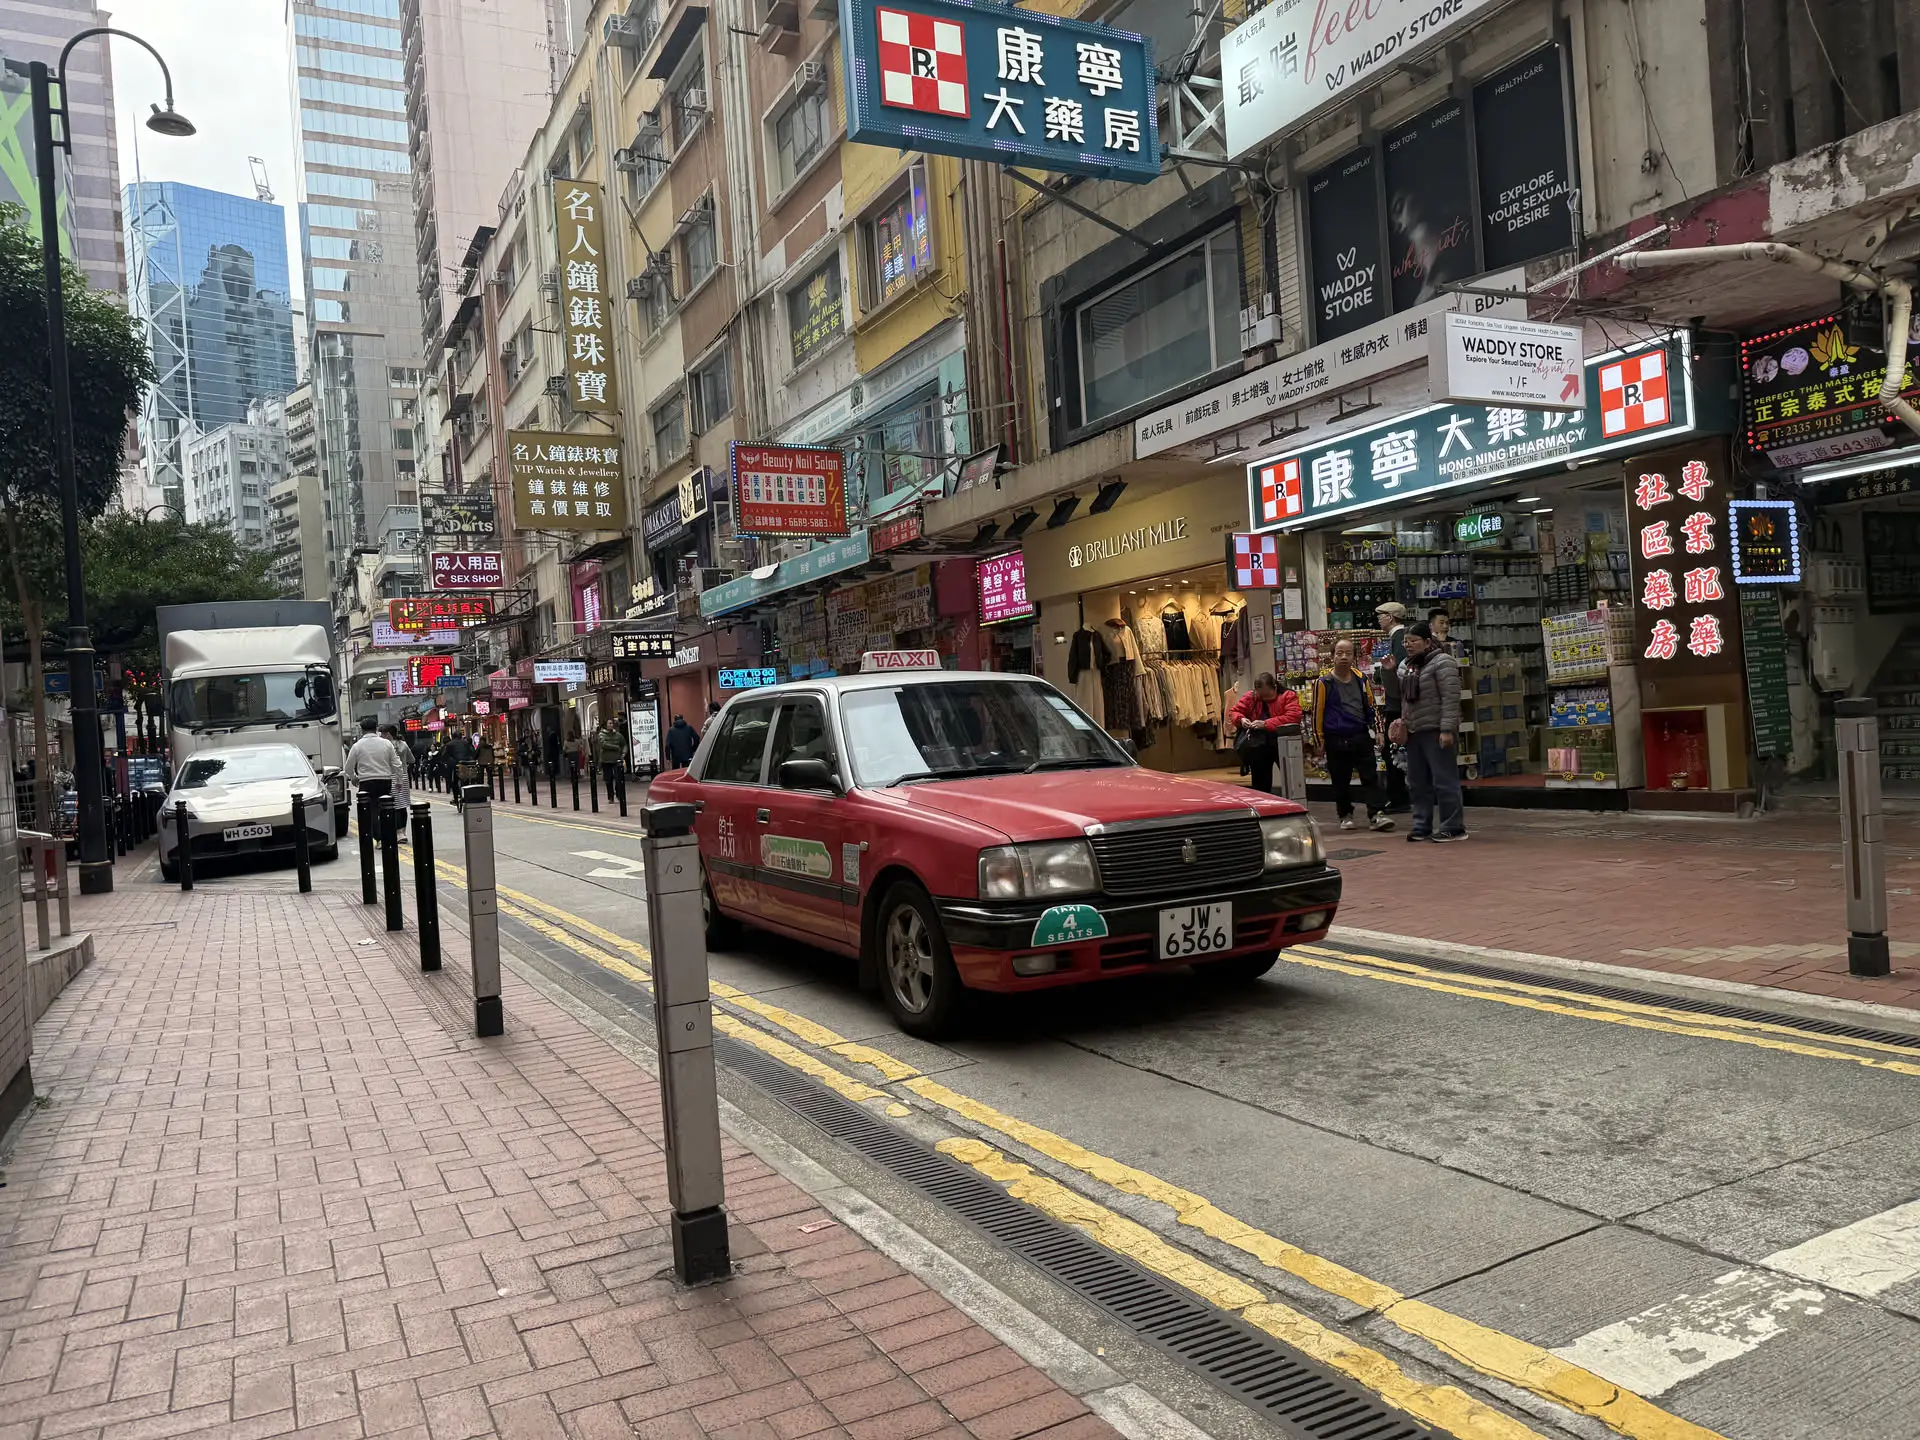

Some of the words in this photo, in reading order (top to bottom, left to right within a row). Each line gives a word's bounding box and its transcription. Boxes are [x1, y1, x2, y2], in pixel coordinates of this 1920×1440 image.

[1236, 18, 1266, 48] 成人玩具
[1350, 27, 1406, 76] WADDY
[1409, 0, 1464, 40] STORE
[996, 26, 1124, 97] 康寧
[1238, 32, 1299, 107] 最啱
[1495, 75, 1523, 96] HEALTH
[1523, 63, 1544, 81] CARE
[983, 87, 1141, 153] 大藥房
[1431, 106, 1461, 129] LINGERIE
[1389, 141, 1401, 152] SEX
[1402, 130, 1418, 146] TOYS
[1342, 156, 1371, 176] FOREPLAY
[1500, 170, 1555, 205] EXPLORE
[1487, 202, 1520, 225] YOUR
[1523, 180, 1570, 211] SEXUAL
[1507, 204, 1551, 233] DESIRE
[1321, 263, 1376, 302] WADDY
[562, 187, 607, 405] 名人鐘錶珠寶
[1325, 286, 1373, 321] STORE
[1462, 336, 1517, 357] WADDY
[1520, 342, 1563, 362] STORE
[1466, 354, 1488, 365] Explore
[1488, 356, 1501, 366] Your
[1501, 357, 1519, 367] Sexual
[1519, 358, 1537, 369] Desire
[1141, 418, 1173, 442] 成人玩具
[1185, 399, 1221, 426] 前戲玩意
[1231, 380, 1270, 408] 男士增強
[1282, 358, 1325, 389] 女士愉悅
[1341, 333, 1390, 366] 性感內衣
[1278, 385, 1305, 402] WADDY
[1306, 376, 1330, 393] STORE
[1754, 389, 1795, 406] PERFECT
[1800, 382, 1823, 394] THAI
[1825, 369, 1877, 389] MASSAGE
[1815, 415, 1843, 429] 9118
[512, 443, 619, 465] 名人鐘錶珠寶
[762, 452, 793, 472] Beauty
[795, 453, 812, 470] Nail
[814, 455, 839, 471] Salon
[1438, 457, 1473, 476] HONG
[1475, 448, 1507, 466] NING
[1509, 427, 1587, 458] PHARMACY
[1469, 466, 1487, 477] HONG
[1489, 461, 1505, 472] NING
[1507, 453, 1539, 468] MEDICINE
[1541, 446, 1568, 460] LIMITED
[513, 464, 534, 474] VIP
[536, 465, 566, 475] Watch
[567, 466, 576, 476] &
[578, 467, 620, 480] Jewellery
[528, 479, 610, 498] 鐘錶維修
[529, 499, 612, 518] 高價買取
[1458, 516, 1502, 537] 信心保證
[1086, 527, 1147, 563] BRILLIANT
[435, 555, 499, 571] 成人用品
[985, 559, 1011, 575] YoYo
[1634, 472, 1680, 661] 社區藥房
[1678, 459, 1724, 657] 專業配藥
[450, 574, 470, 583] SEX
[472, 574, 500, 583] SHOP
[627, 640, 672, 652] 生命水晶
[871, 650, 936, 668] TAXI
[225, 830, 240, 839] WH
[243, 825, 271, 837] 6503
[718, 815, 734, 837] 的士
[718, 835, 735, 858] TAXI
[1063, 913, 1078, 930] 4
[1181, 906, 1211, 931] JW
[1048, 928, 1093, 942] SEATS
[1166, 926, 1227, 956] 6566
